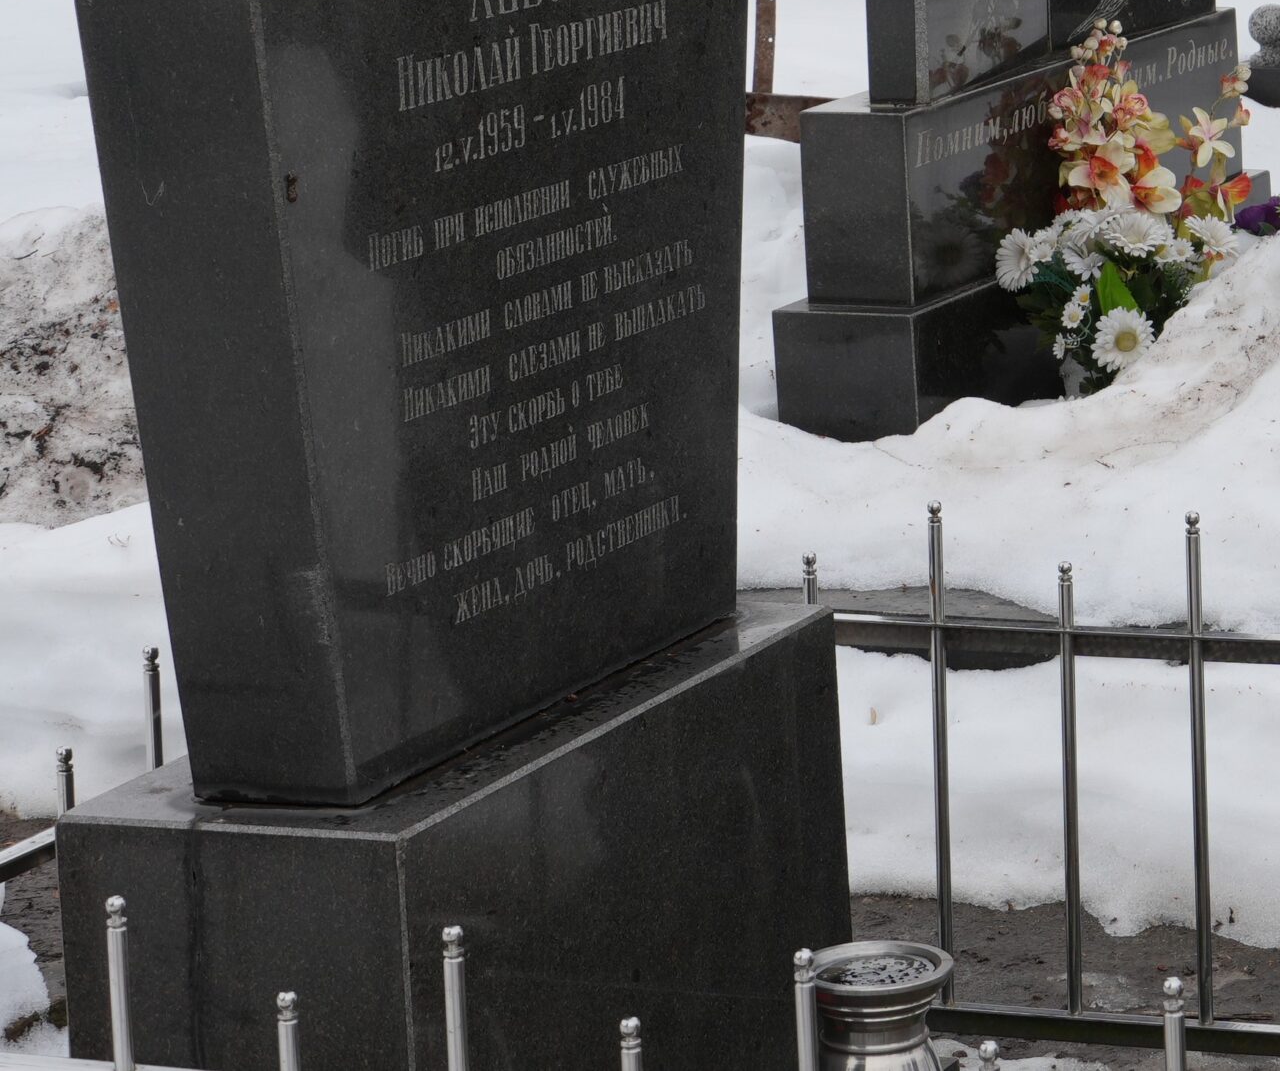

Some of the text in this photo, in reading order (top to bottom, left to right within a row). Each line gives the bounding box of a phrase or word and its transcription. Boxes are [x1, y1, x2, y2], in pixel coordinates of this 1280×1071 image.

[433, 212, 466, 251] ПРИ
[474, 179, 571, 237] ИСПОЛНЕНИИ
[587, 143, 684, 201] СЛУЖЕБНЫХ
[504, 280, 573, 331] СЛОВАМИ
[581, 270, 598, 302] НЕ
[604, 239, 693, 294] ВЫСКАЗАТЬ
[508, 329, 581, 382] СЛЕЗАМИ
[588, 321, 606, 352] НЕ
[614, 283, 706, 342] ВЫПЛАКАТЬ
[508, 386, 566, 434] СКОРБЬ
[571, 379, 580, 408] О
[586, 363, 624, 401] ТЕБЕ
[520, 424, 577, 481] РОДНОЙ
[587, 401, 650, 451] ЧЕЛОВЕК
